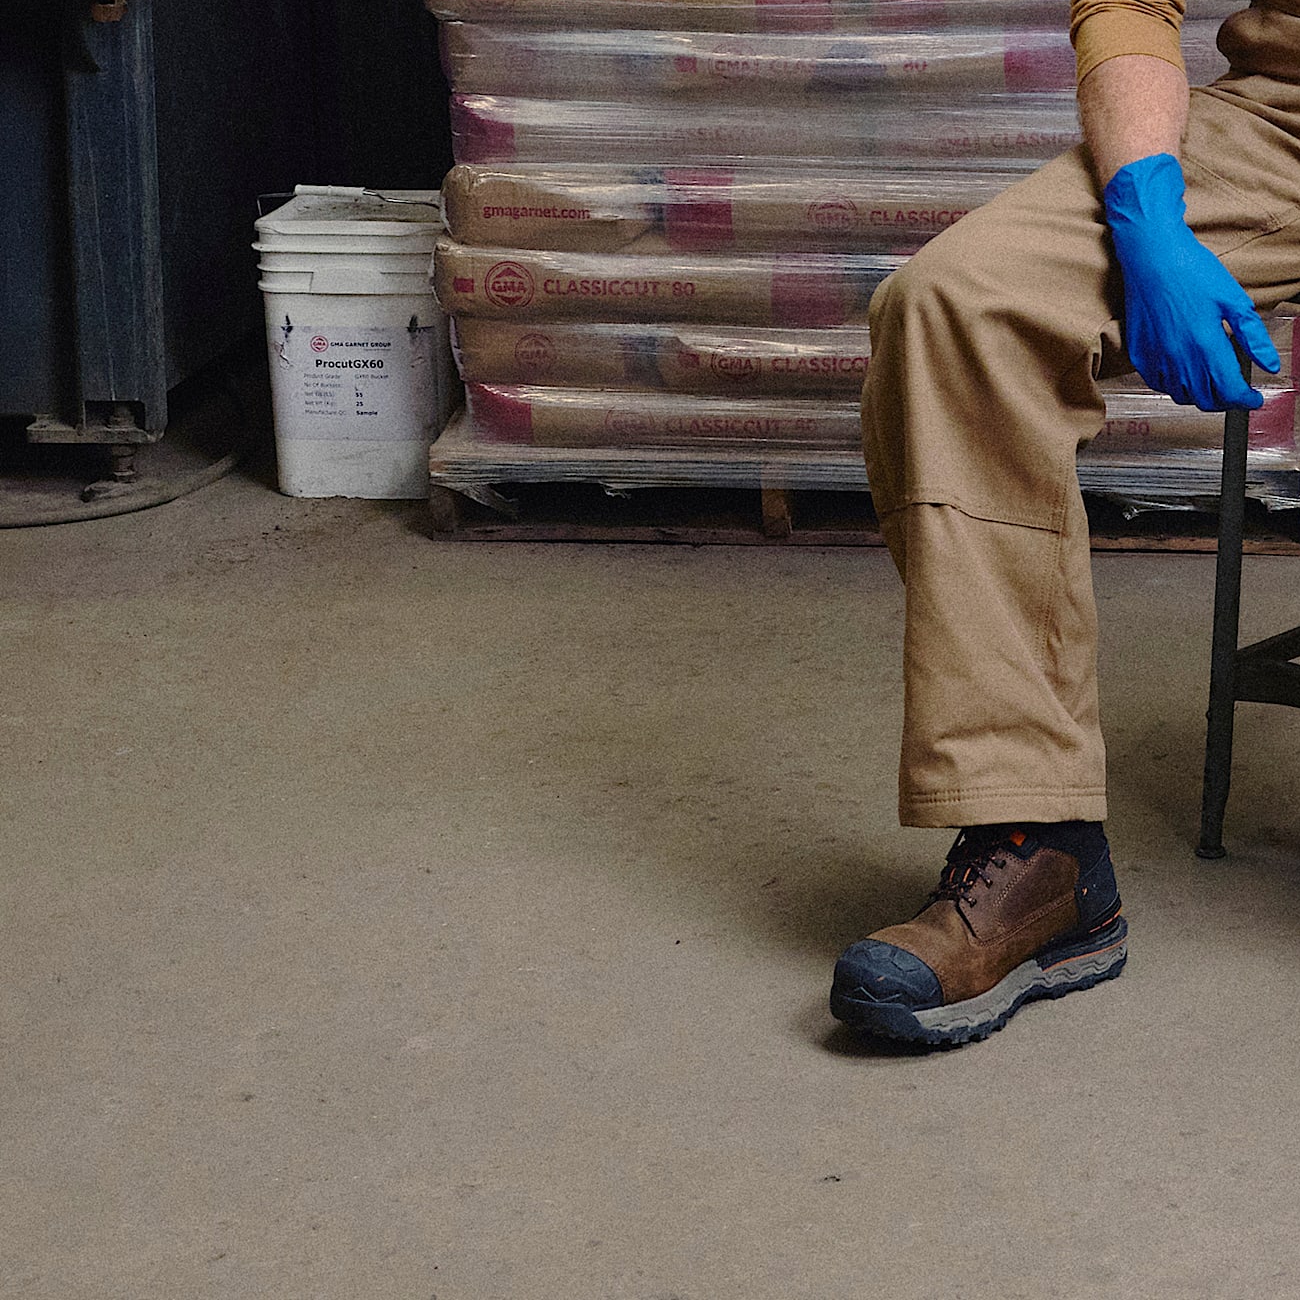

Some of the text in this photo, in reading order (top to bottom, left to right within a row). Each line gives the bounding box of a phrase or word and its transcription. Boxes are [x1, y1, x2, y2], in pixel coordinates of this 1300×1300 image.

[483, 205, 590, 219] gmagarnet.com
[491, 280, 527, 294] GMA
[672, 281, 696, 297] 80
[315, 359, 384, 369] ProcutGX60
[718, 358, 753, 371] GMA
[1126, 420, 1150, 437] 80
